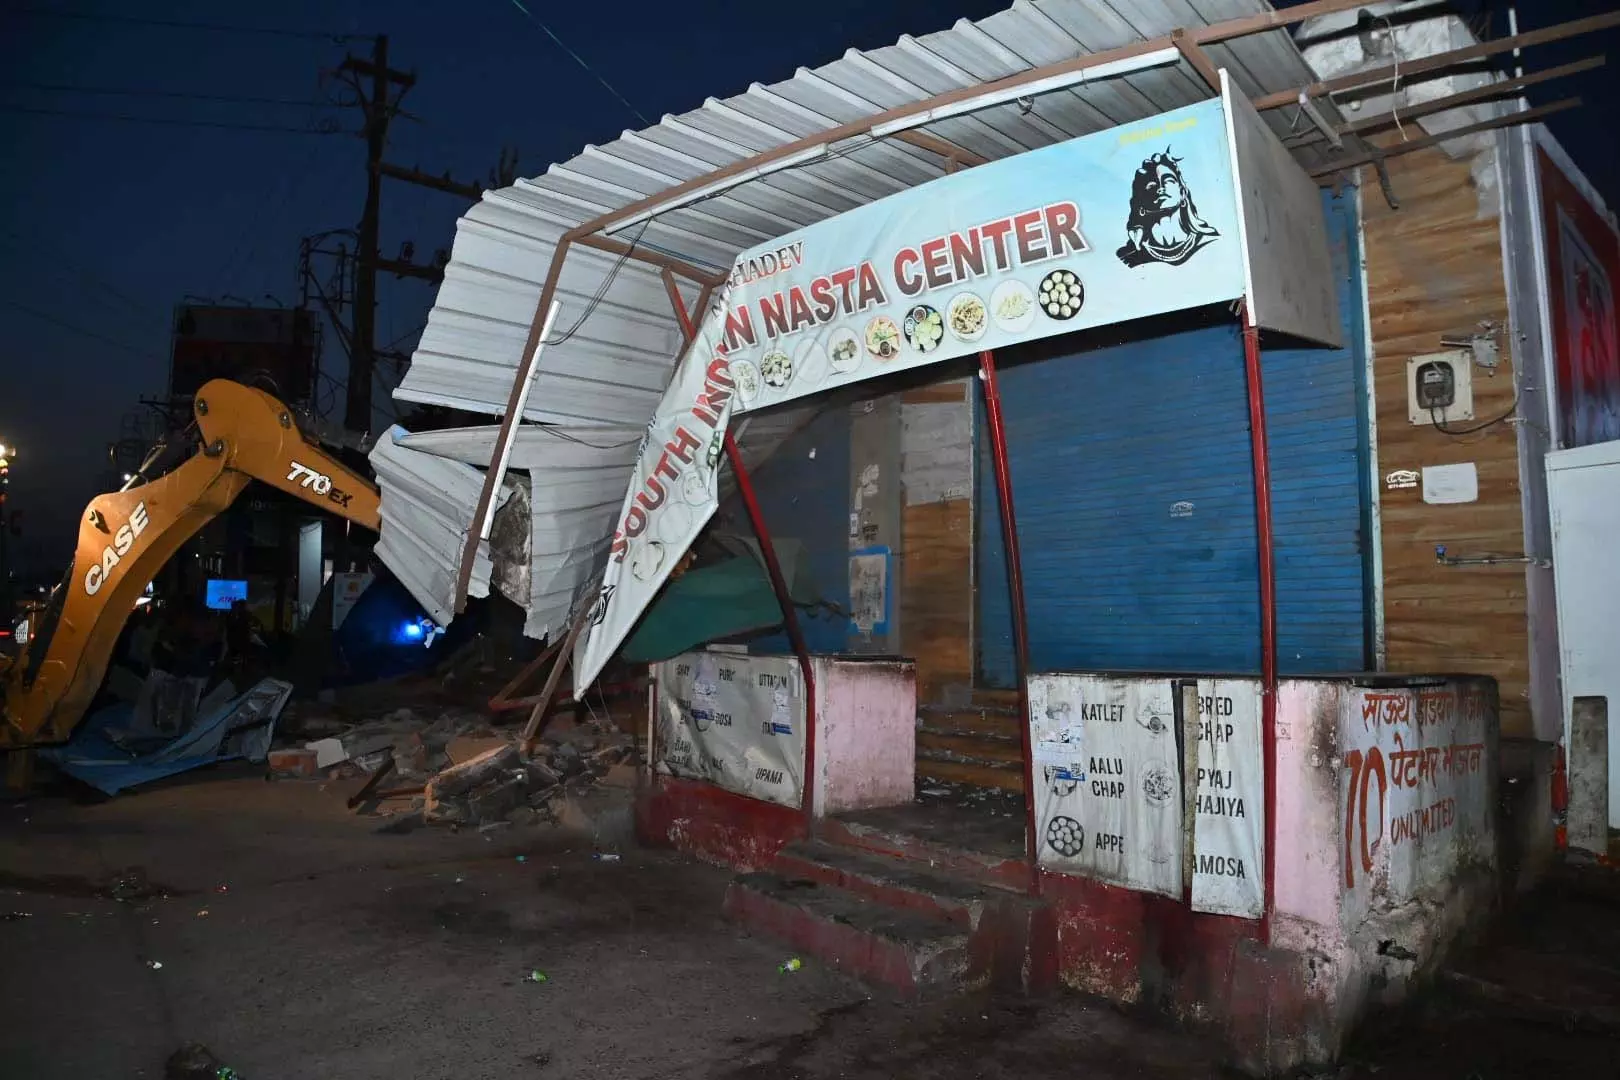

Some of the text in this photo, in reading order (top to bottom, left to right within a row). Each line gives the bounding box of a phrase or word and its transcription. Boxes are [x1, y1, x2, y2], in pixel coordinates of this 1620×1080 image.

[611, 424, 702, 564] SOUTH
[760, 262, 887, 338] NASTA
[893, 202, 1088, 295] CENTER
[84, 501, 150, 596] CASE
[1082, 703, 1125, 722] KATLET
[1197, 695, 1233, 717] BRED
[1197, 723, 1234, 743] CHAP
[755, 768, 783, 784] UPAMA
[1090, 757, 1123, 775] AALU
[1197, 768, 1232, 789] PYAJ
[1092, 781, 1125, 799] CHAP
[1196, 795, 1245, 818] HAJIYA
[1391, 797, 1455, 845] UNLIMITED
[1096, 832, 1124, 853] APPE
[1192, 855, 1245, 879] AMOSA
